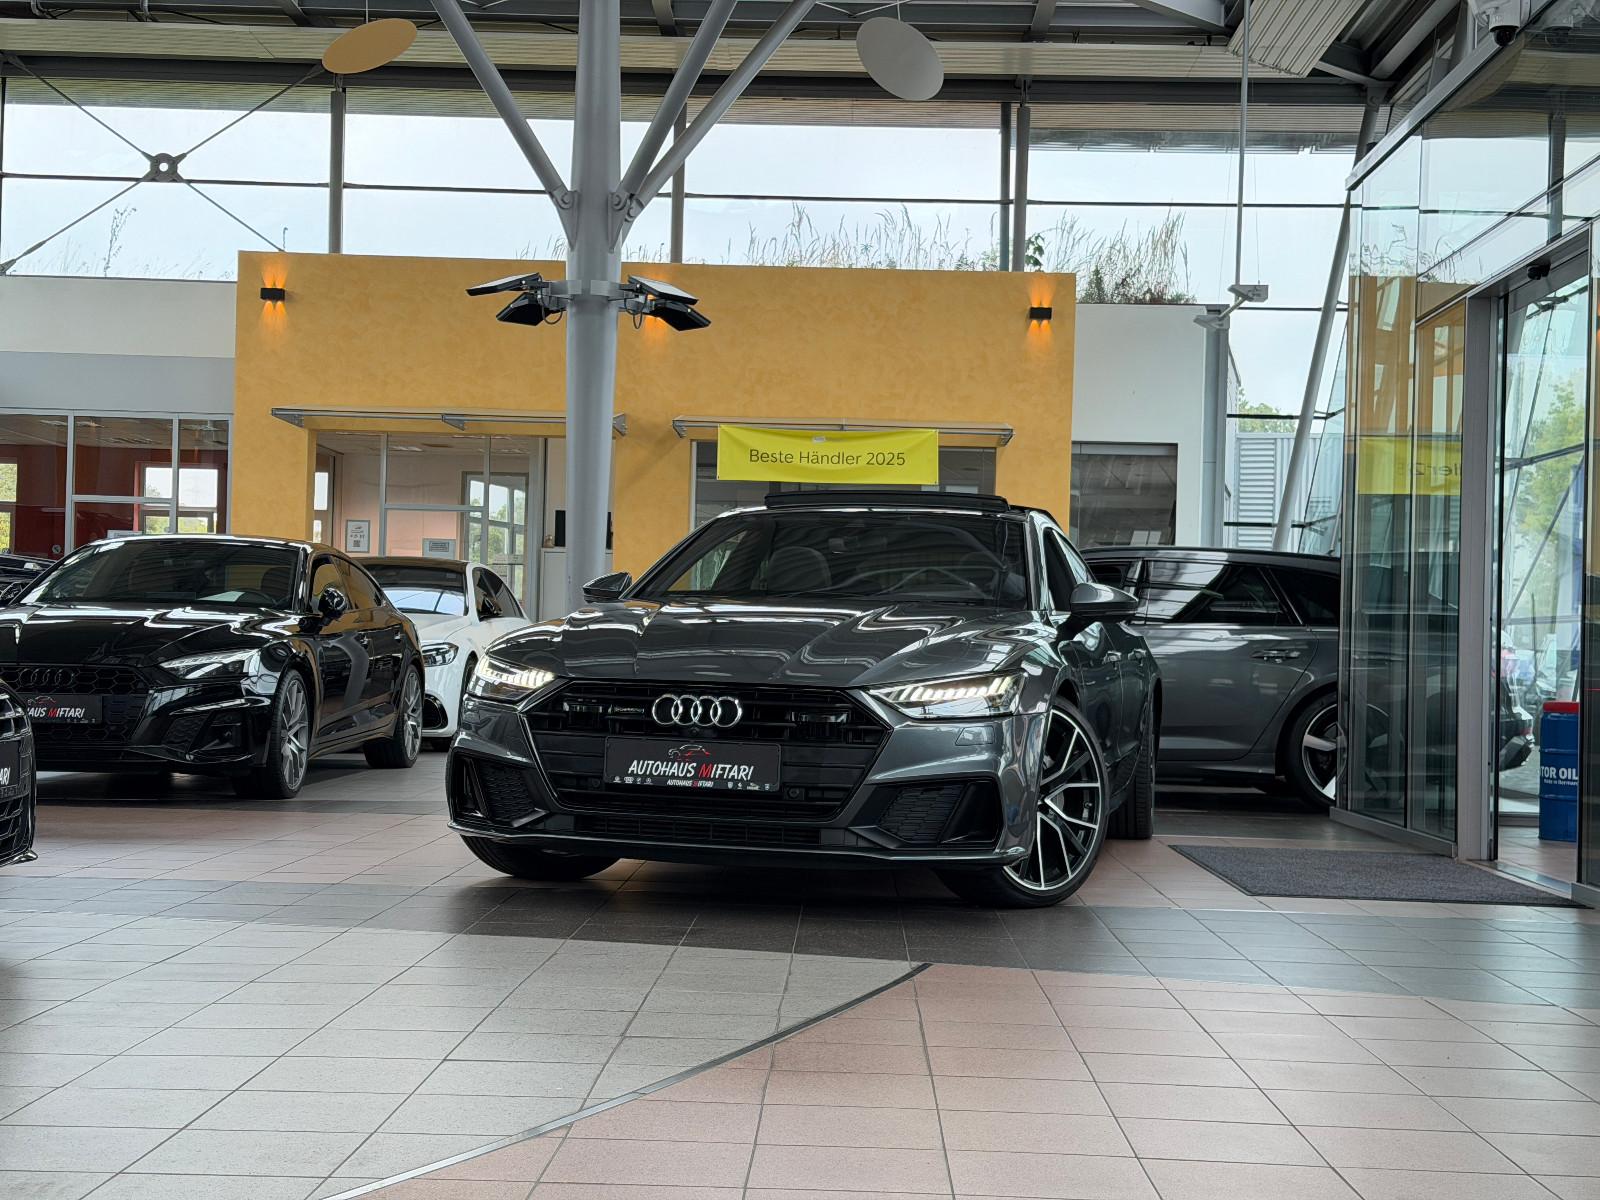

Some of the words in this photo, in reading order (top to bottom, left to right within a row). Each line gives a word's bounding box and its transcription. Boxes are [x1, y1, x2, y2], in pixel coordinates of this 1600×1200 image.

[750, 449, 794, 464] Beste
[799, 450, 862, 466] Händler
[866, 452, 906, 466] 2025
[27, 706, 47, 718] AUS
[47, 707, 85, 718] MIFTARI
[627, 759, 697, 778] AUTOHAUS
[698, 763, 754, 781] MIFTARI
[1540, 766, 1557, 779] TOR
[1558, 767, 1579, 781] OIL
[666, 779, 693, 787] AUTOHAUS
